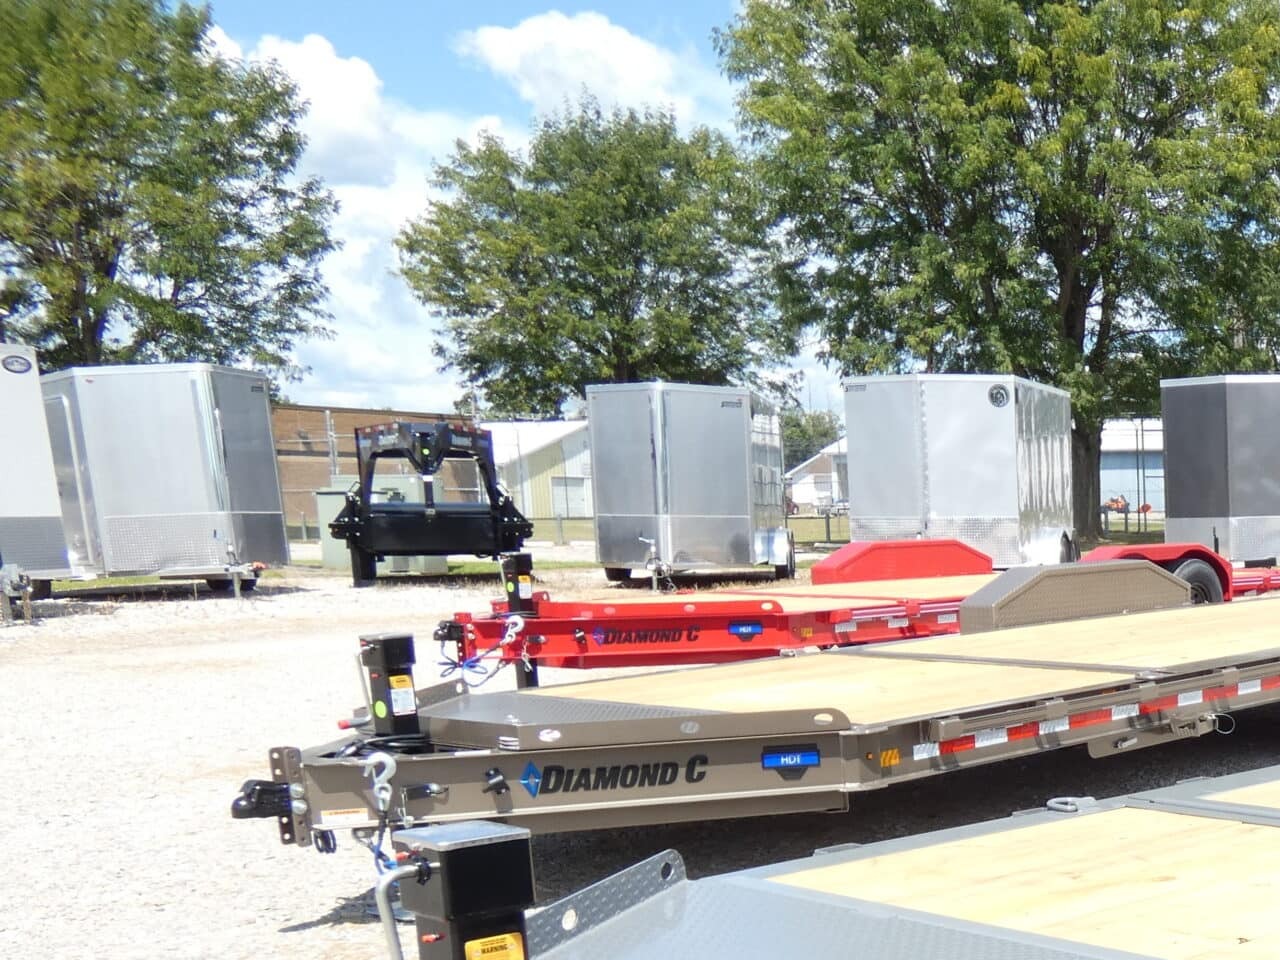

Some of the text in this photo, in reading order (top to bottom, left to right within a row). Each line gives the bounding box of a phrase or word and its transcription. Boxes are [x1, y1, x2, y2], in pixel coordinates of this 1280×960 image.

[604, 625, 699, 645] DIAMOND C
[538, 754, 708, 794] DIAMOND C
